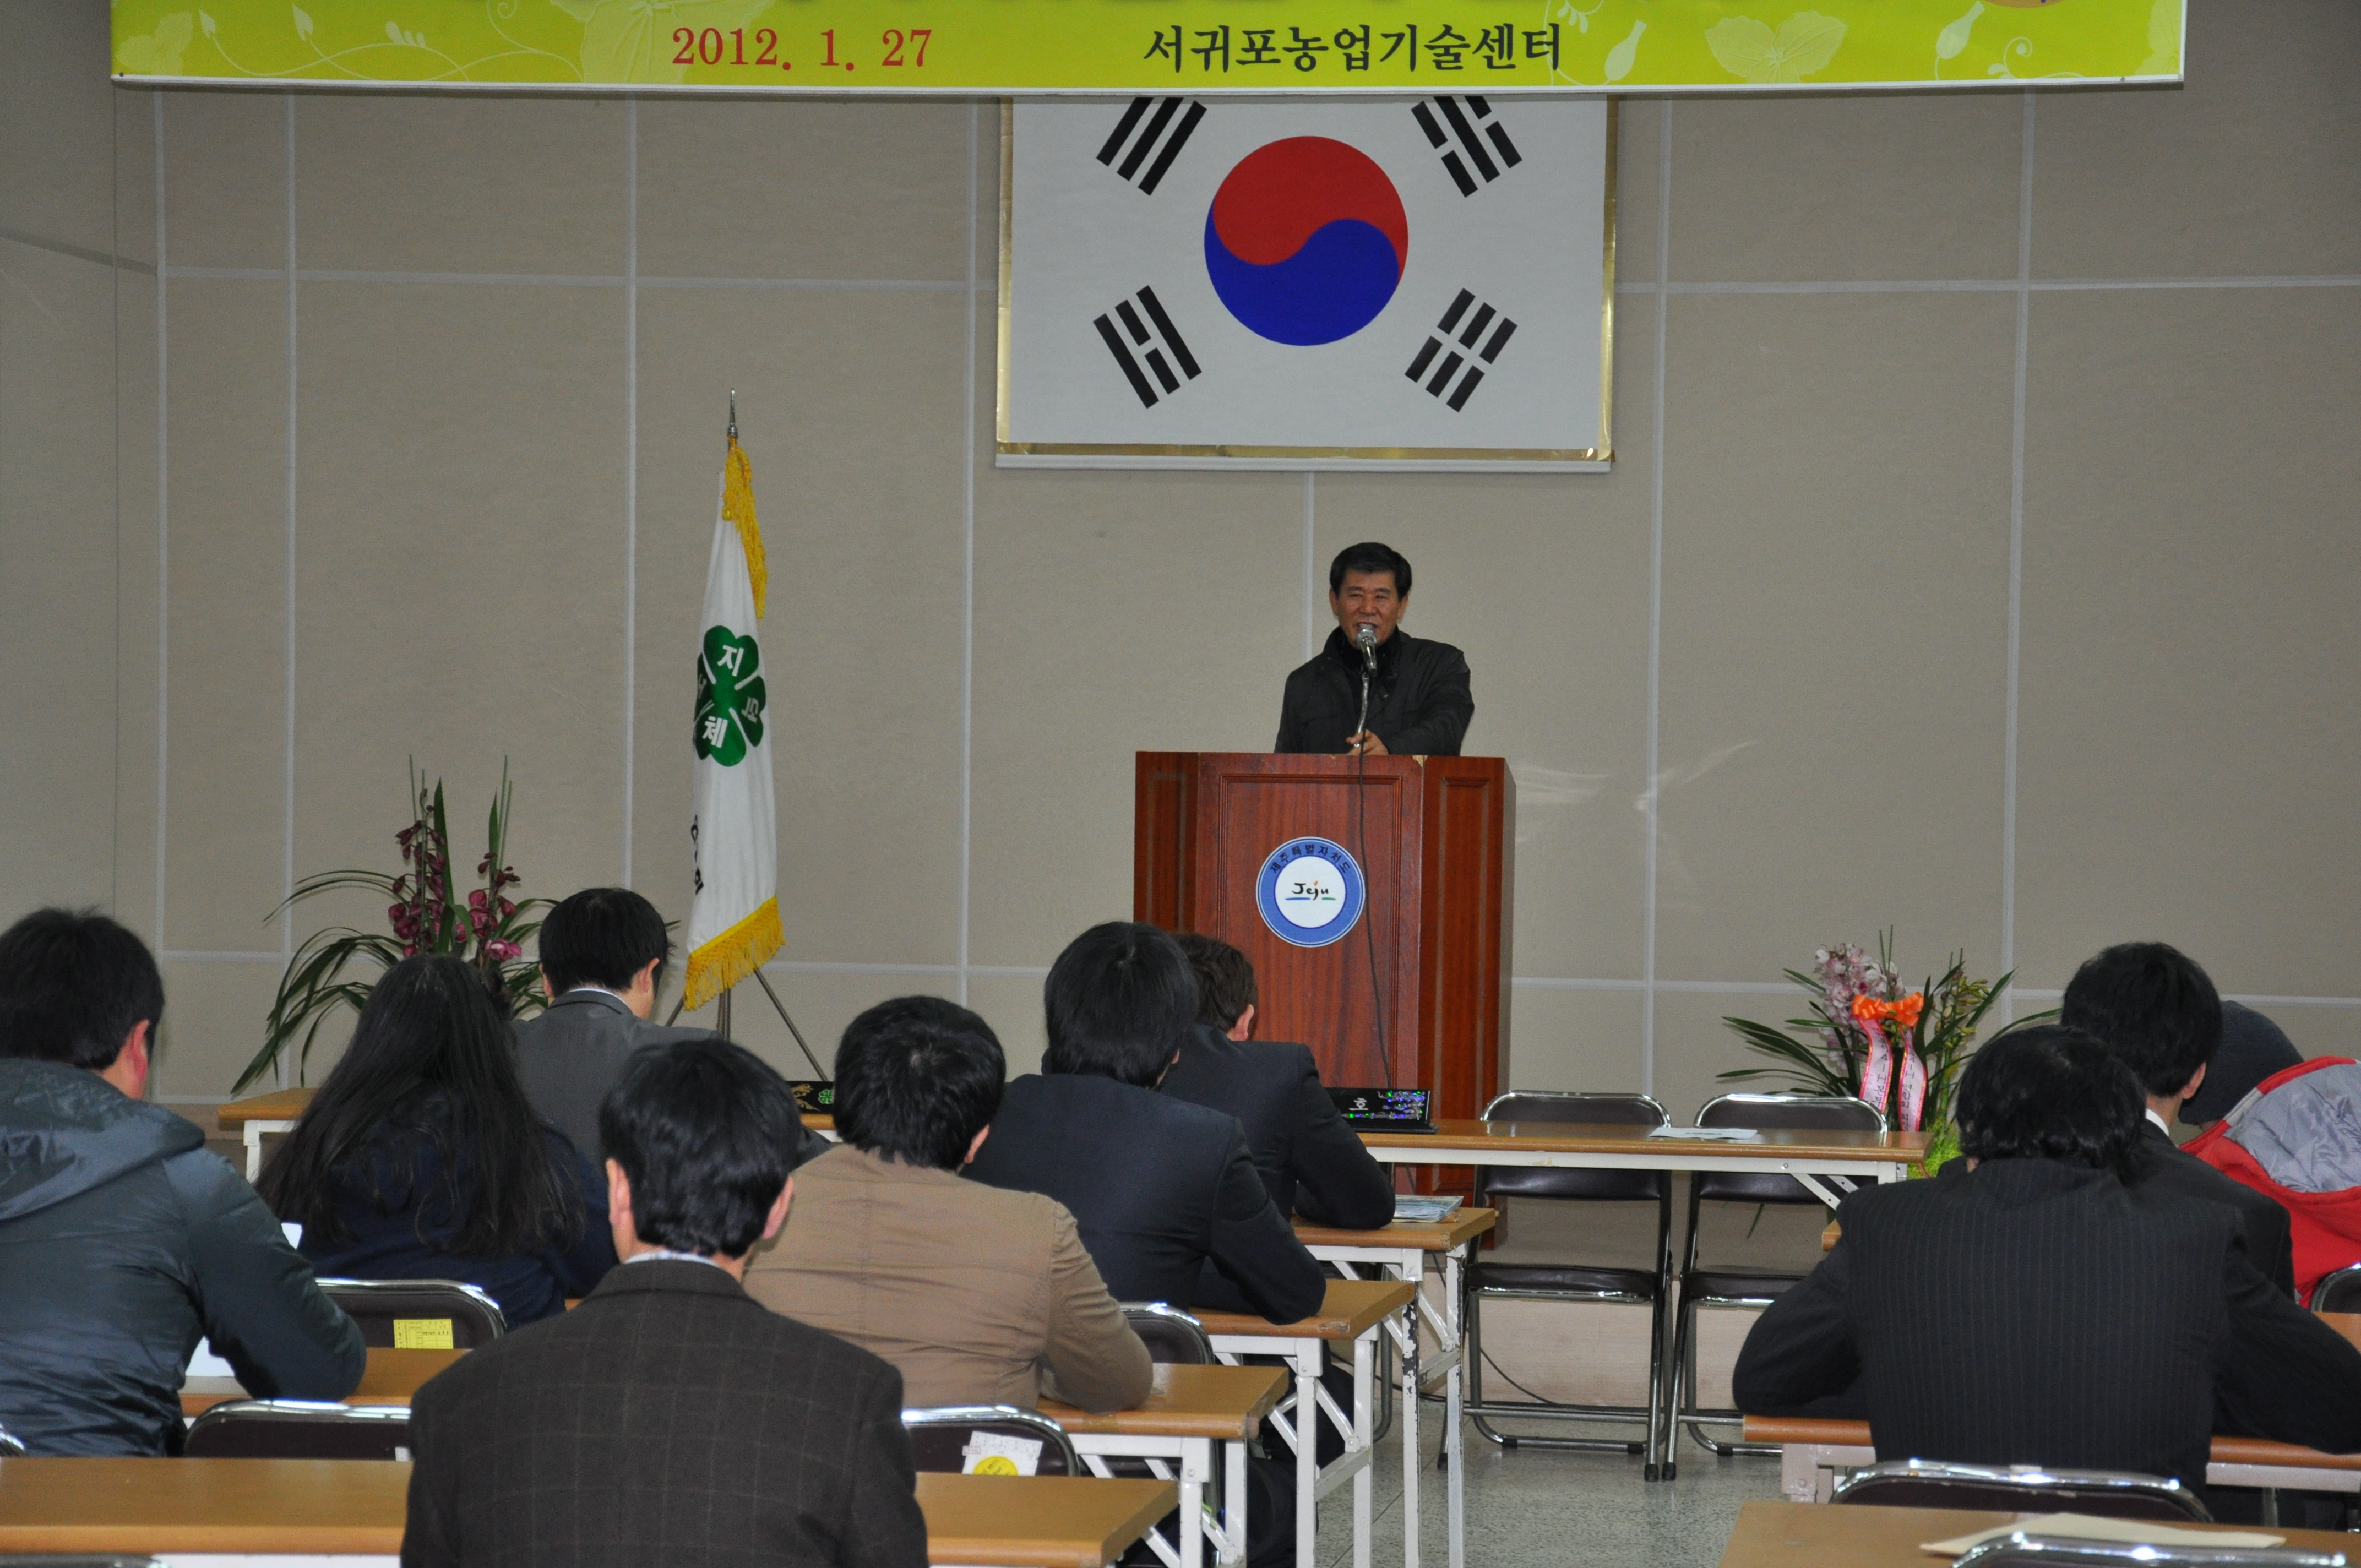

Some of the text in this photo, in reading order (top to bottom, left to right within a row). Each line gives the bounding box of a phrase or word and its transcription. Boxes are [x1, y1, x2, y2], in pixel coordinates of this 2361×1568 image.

[672, 27, 932, 71] 2012. 1. 27
[1144, 23, 1560, 73] 서귀포농업기술센터
[717, 644, 744, 677] 지
[1270, 843, 1351, 873] 제주특별자치도
[1291, 881, 1329, 901] Jeju
